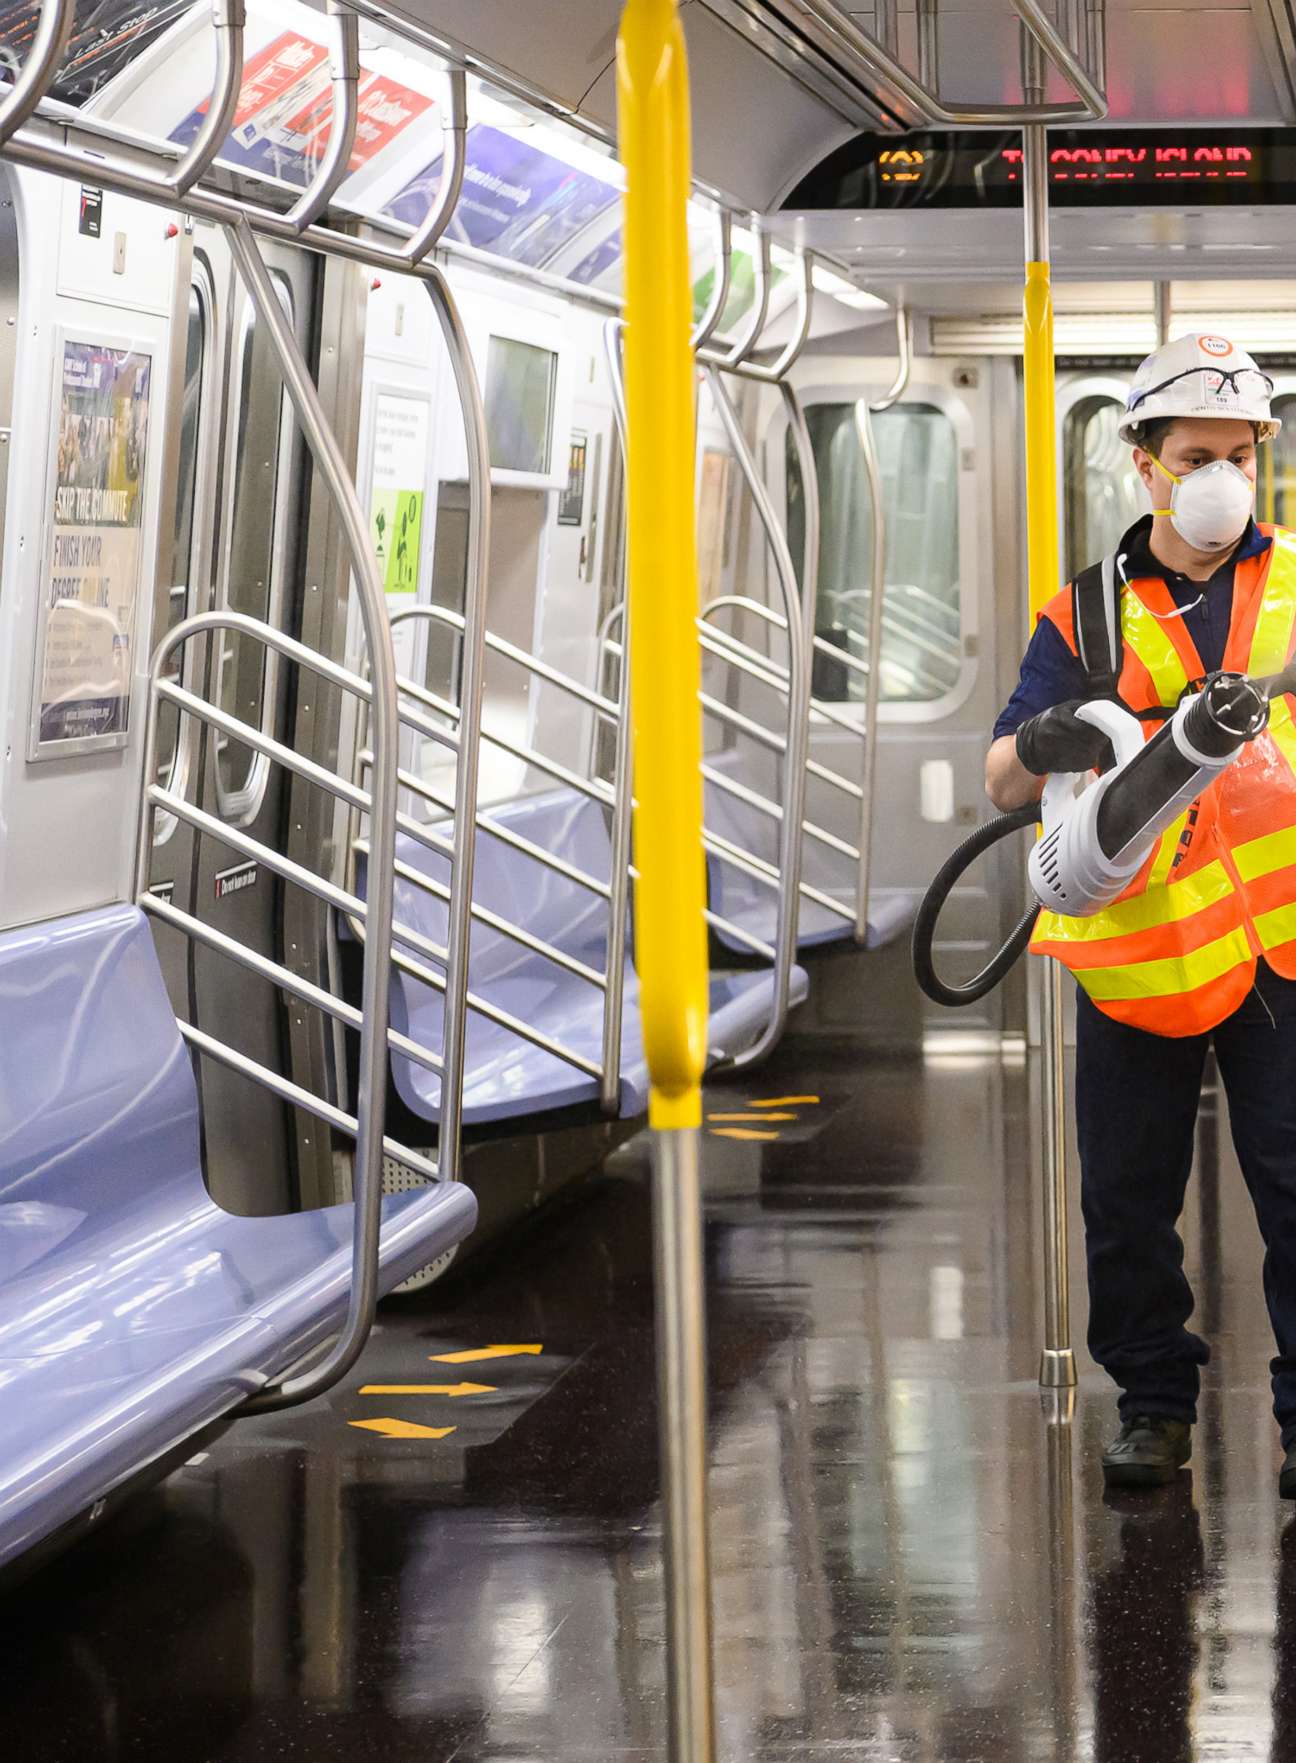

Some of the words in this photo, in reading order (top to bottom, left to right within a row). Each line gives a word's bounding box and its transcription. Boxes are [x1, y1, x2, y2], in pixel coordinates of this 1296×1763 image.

[1051, 149, 1146, 179] CONEY
[1155, 148, 1251, 177] ISLAND
[57, 486, 76, 520] SKIP
[76, 487, 92, 520] THE
[53, 535, 80, 567] FINISH
[80, 536, 102, 567] YOUR
